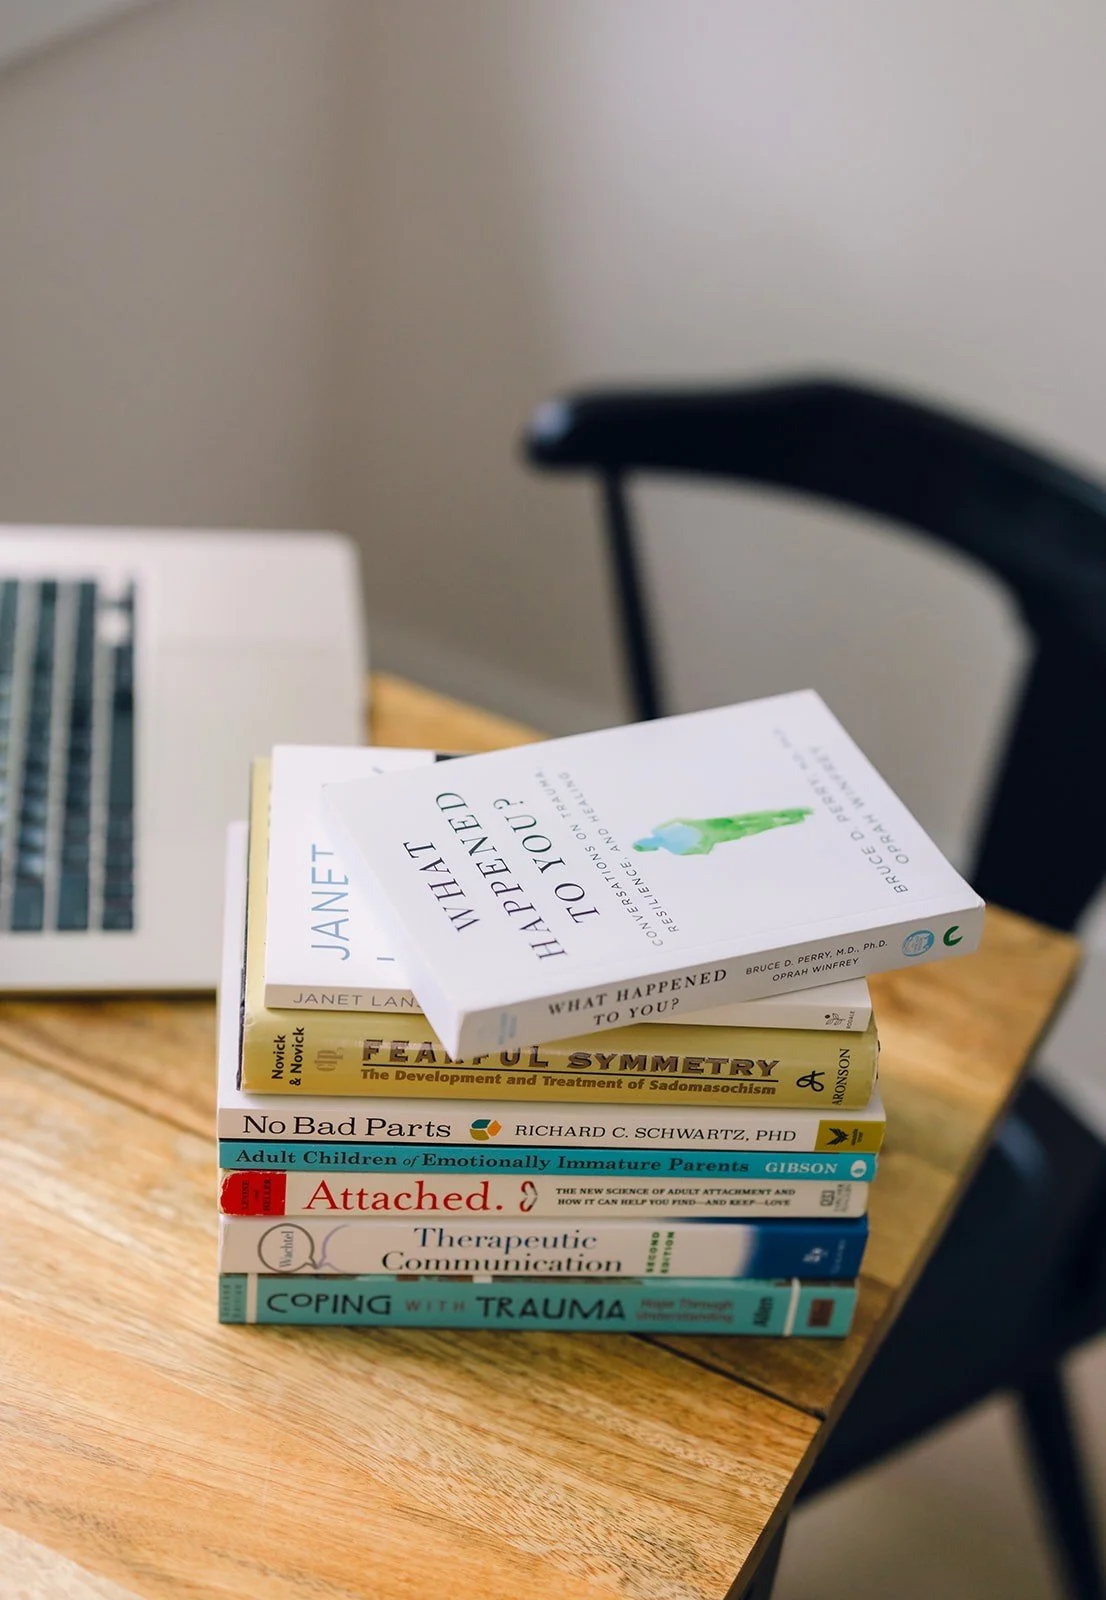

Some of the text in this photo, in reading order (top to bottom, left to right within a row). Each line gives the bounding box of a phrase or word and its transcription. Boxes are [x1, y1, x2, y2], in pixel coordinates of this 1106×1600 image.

[571, 824, 587, 840] ON
[863, 814, 909, 864] OPRAH
[493, 798, 600, 923] TO YOU?
[558, 771, 680, 933] RESILIENCE, AND HEALING
[861, 845, 909, 893] BRUCE
[403, 841, 480, 932] WHAT
[435, 792, 567, 960] HAPPENED
[311, 844, 350, 960] JANET
[584, 845, 663, 947] CONVERSATIONS
[745, 961, 781, 975] BRUCE
[784, 958, 794, 967] D.
[797, 950, 833, 964] PERRY,
[863, 940, 888, 950] Ph.D.
[772, 957, 860, 982] OPRAH WINFREY
[293, 993, 363, 1006] JANET
[548, 968, 727, 1015] WHAT HAPPENED
[593, 998, 680, 1025] TO YOU?
[272, 1034, 286, 1080] Novick
[289, 1027, 305, 1086] & Novick
[566, 1051, 780, 1077] SYMMETRY
[361, 1068, 777, 1095] The Development and Treatment of Sadomasochism
[832, 1048, 851, 1106] ARONSON
[242, 1115, 451, 1138] No Bad Parts
[514, 1125, 797, 1142] RICHARD C. SCHWARTZ, PHD
[235, 1150, 750, 1173] Adult Children of Emotionally Immature Parents
[765, 1162, 838, 1174] GIBSON
[302, 1180, 504, 1212] Attached.
[556, 1187, 576, 1195] THE
[702, 1188, 772, 1196] ATTACHMENT
[278, 1230, 295, 1268] Wachtel
[414, 1227, 597, 1255] Therapeutic
[646, 1232, 660, 1273] SECOND
[660, 1231, 675, 1274] EDITION
[382, 1251, 622, 1272] Communication
[266, 1292, 391, 1316] COPING
[405, 1300, 465, 1313] WITH
[476, 1296, 626, 1320] TRAUMA
